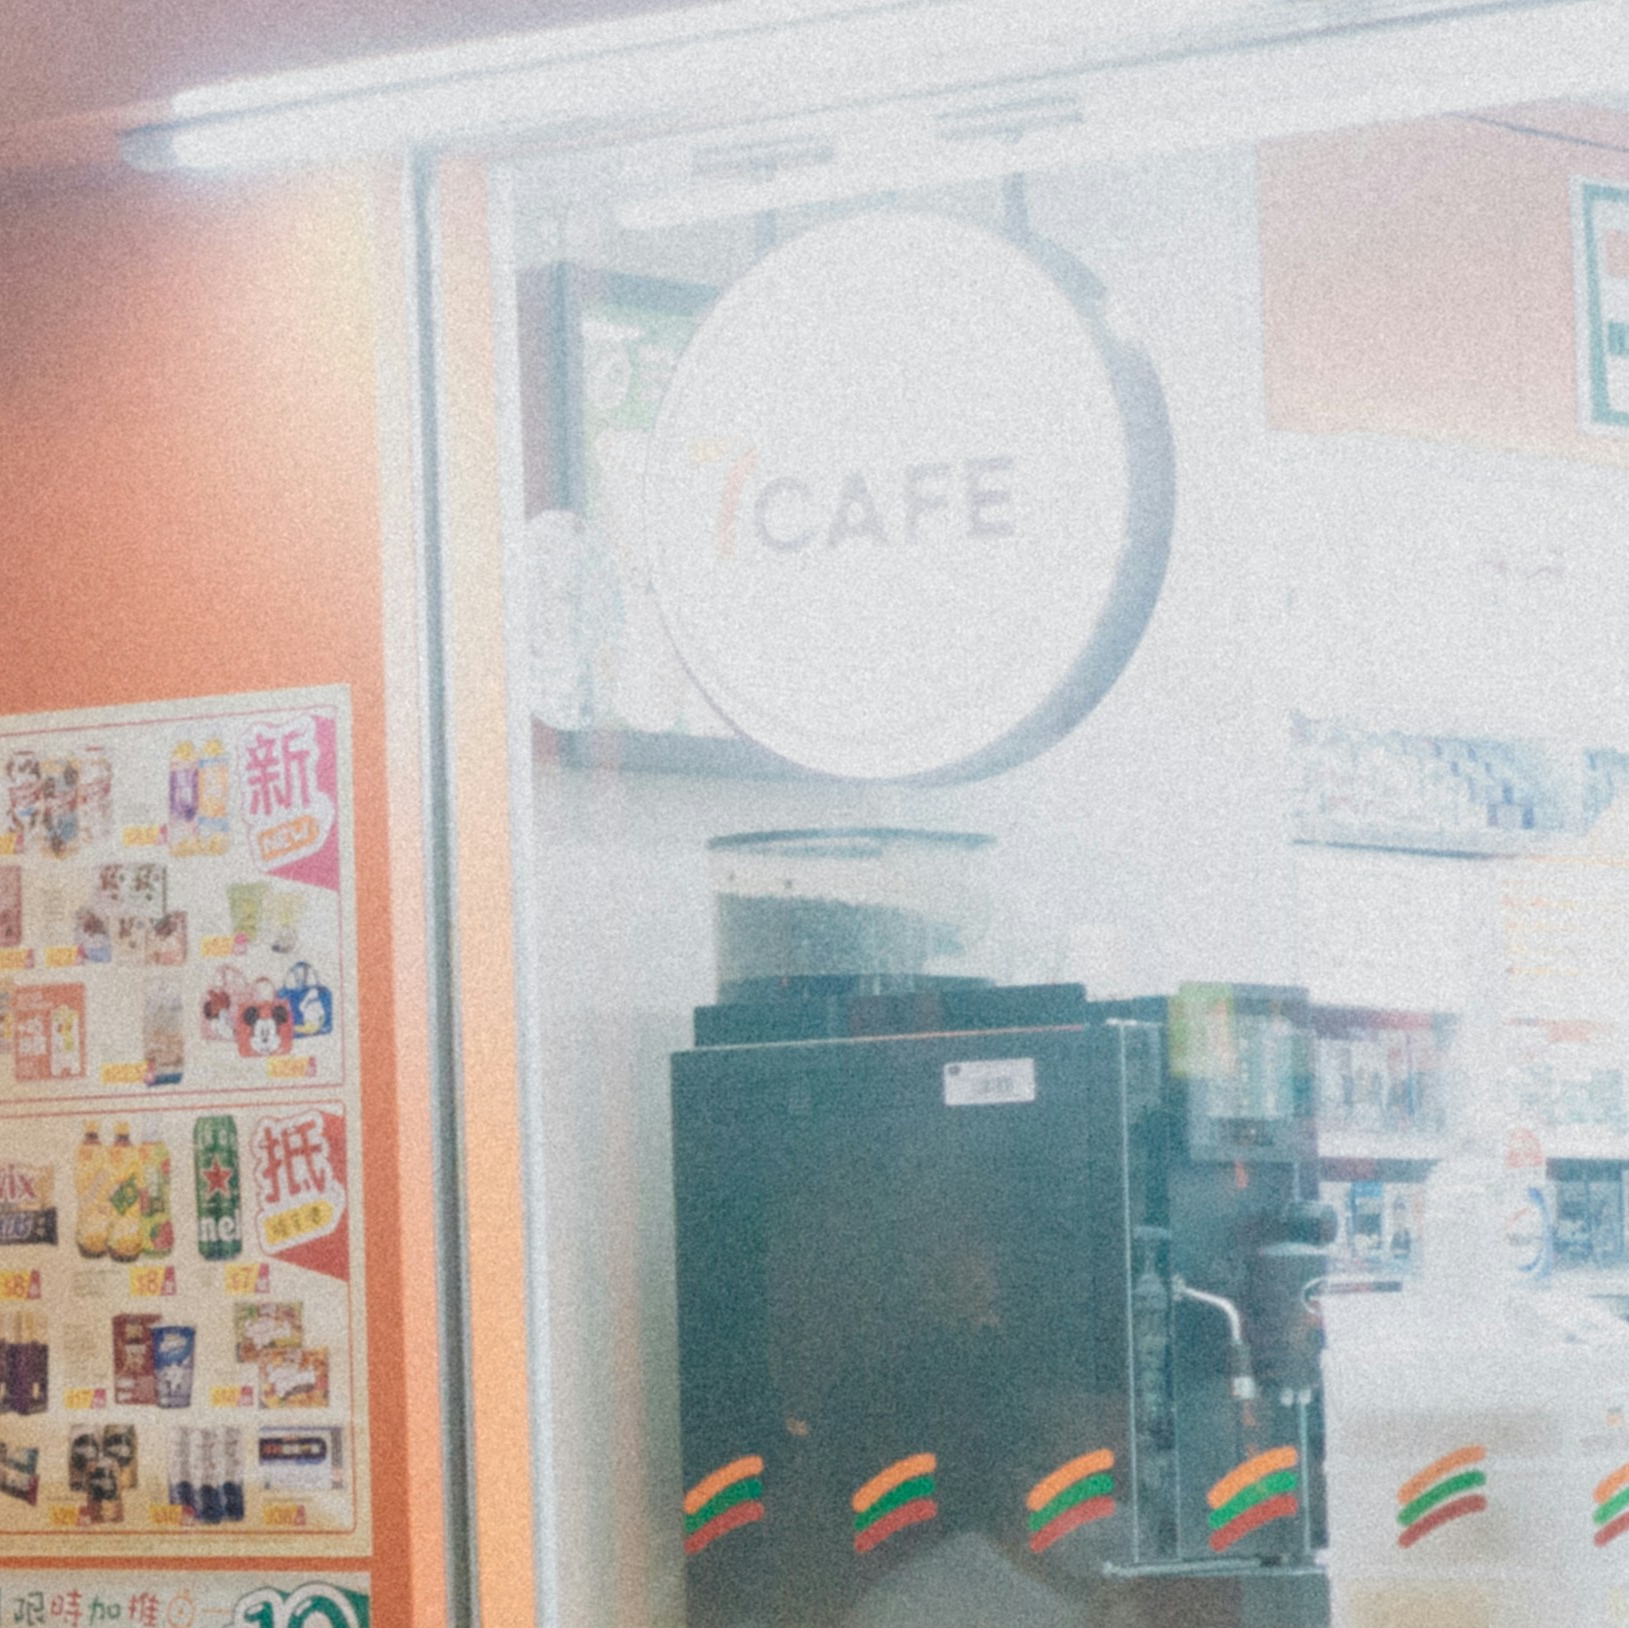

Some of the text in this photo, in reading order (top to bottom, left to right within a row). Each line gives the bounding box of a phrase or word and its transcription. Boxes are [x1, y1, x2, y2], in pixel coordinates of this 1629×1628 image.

[248, 732, 311, 816] 新
[261, 820, 311, 855] NEW
[258, 1120, 326, 1204] 抵
[3, 1273, 27, 1297] $8
[136, 1269, 158, 1295] $8
[229, 1267, 253, 1291] $7
[13, 1589, 160, 1628] 限時加推
